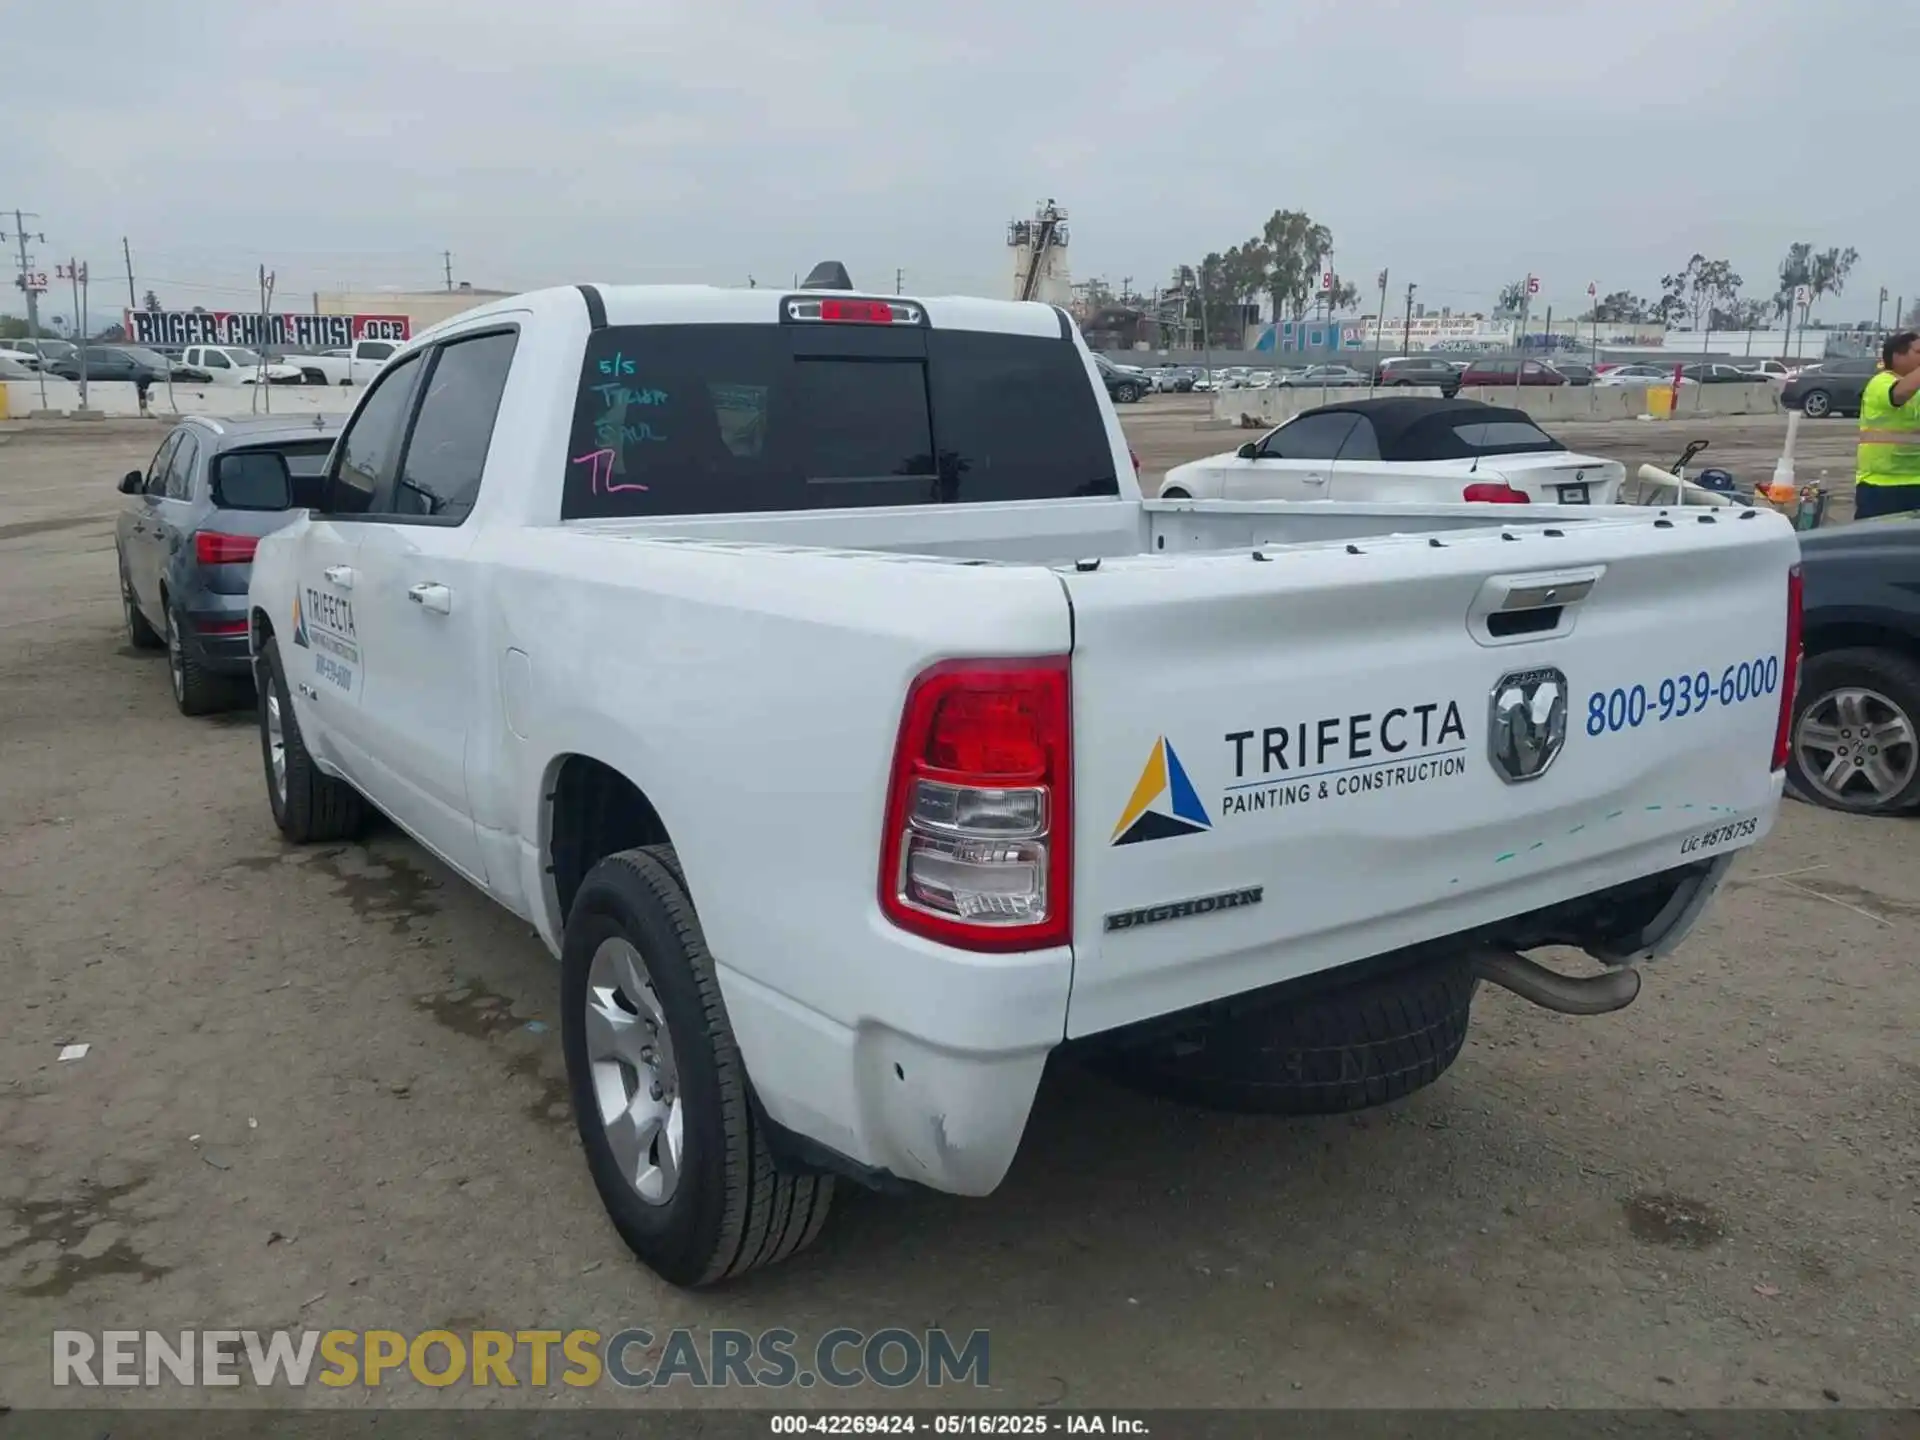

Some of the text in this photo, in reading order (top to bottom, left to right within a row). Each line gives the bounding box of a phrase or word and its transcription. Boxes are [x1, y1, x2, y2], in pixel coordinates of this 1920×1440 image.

[1528, 277, 1540, 293] 5
[1587, 281, 1596, 296] 4
[1796, 287, 1805, 300] 2
[599, 351, 637, 377] 5/5
[306, 587, 358, 639] TRIFECTA
[1586, 655, 1779, 736] 800-939-6000
[1225, 700, 1466, 777] TRIFECTA
[1222, 756, 1466, 816] PAINTING & CONSTRUCTION
[1680, 836, 1700, 855] Lic
[1104, 884, 1264, 932] BIGHORN
